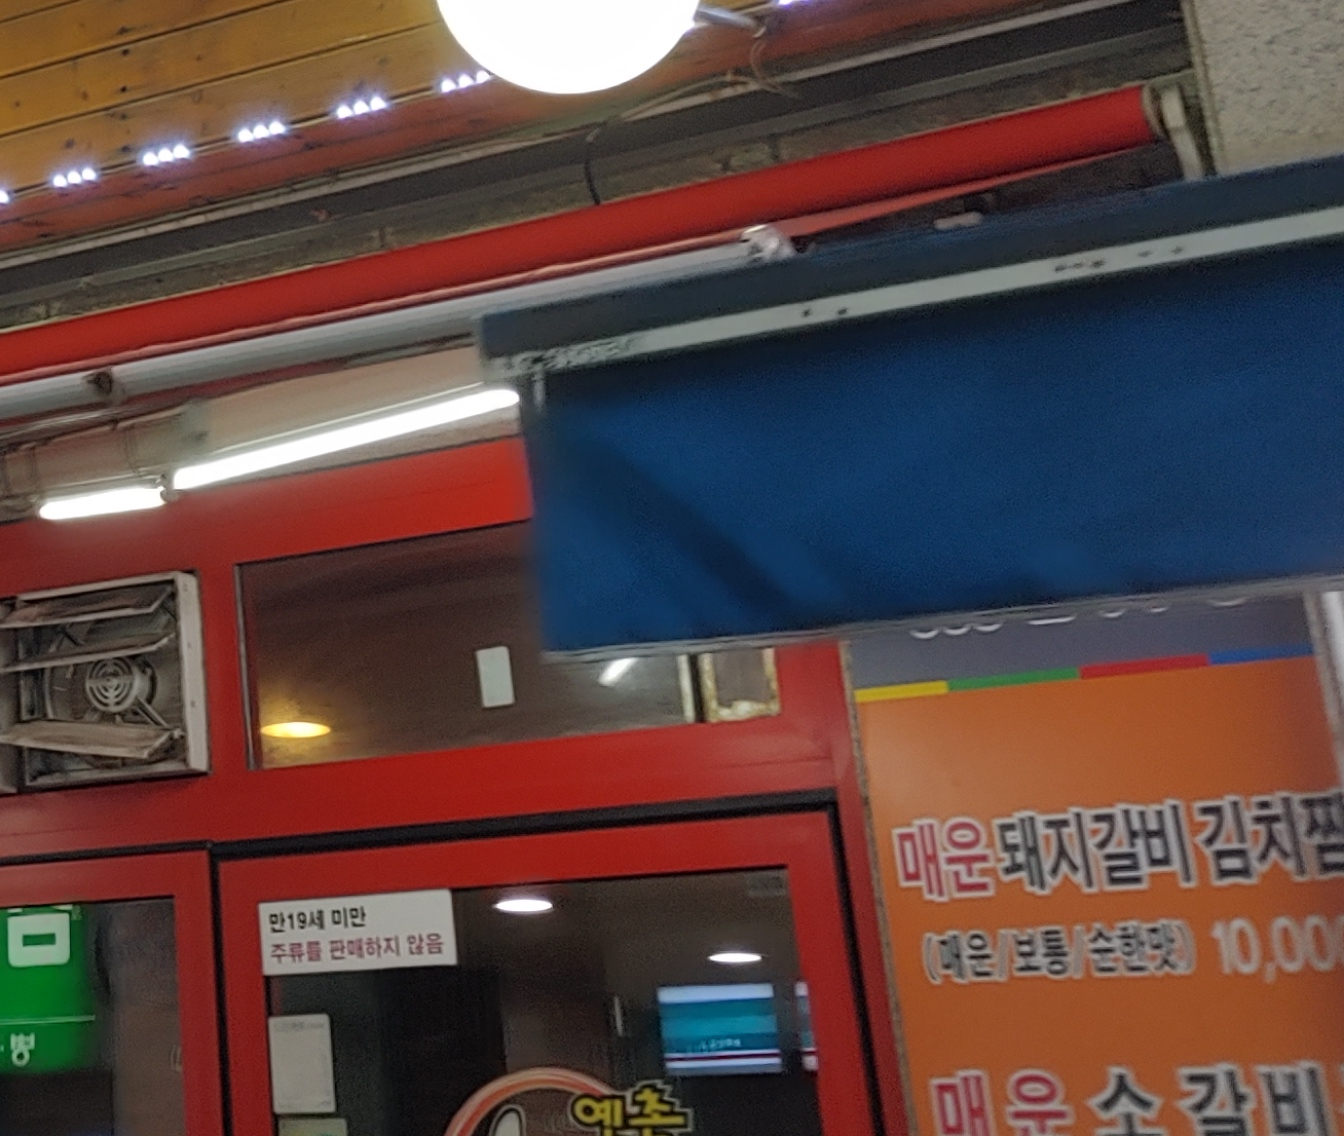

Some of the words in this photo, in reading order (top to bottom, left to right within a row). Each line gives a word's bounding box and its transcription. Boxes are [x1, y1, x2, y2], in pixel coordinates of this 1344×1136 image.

[895, 820, 994, 899] 매운
[997, 802, 1193, 891] 돼지갈비
[269, 909, 325, 933] 만19세
[331, 906, 367, 929] 미만
[270, 941, 323, 963] 주류를
[329, 936, 401, 960] 판매하지
[407, 933, 445, 956] 않음
[1213, 916, 1344, 982] 10,00
